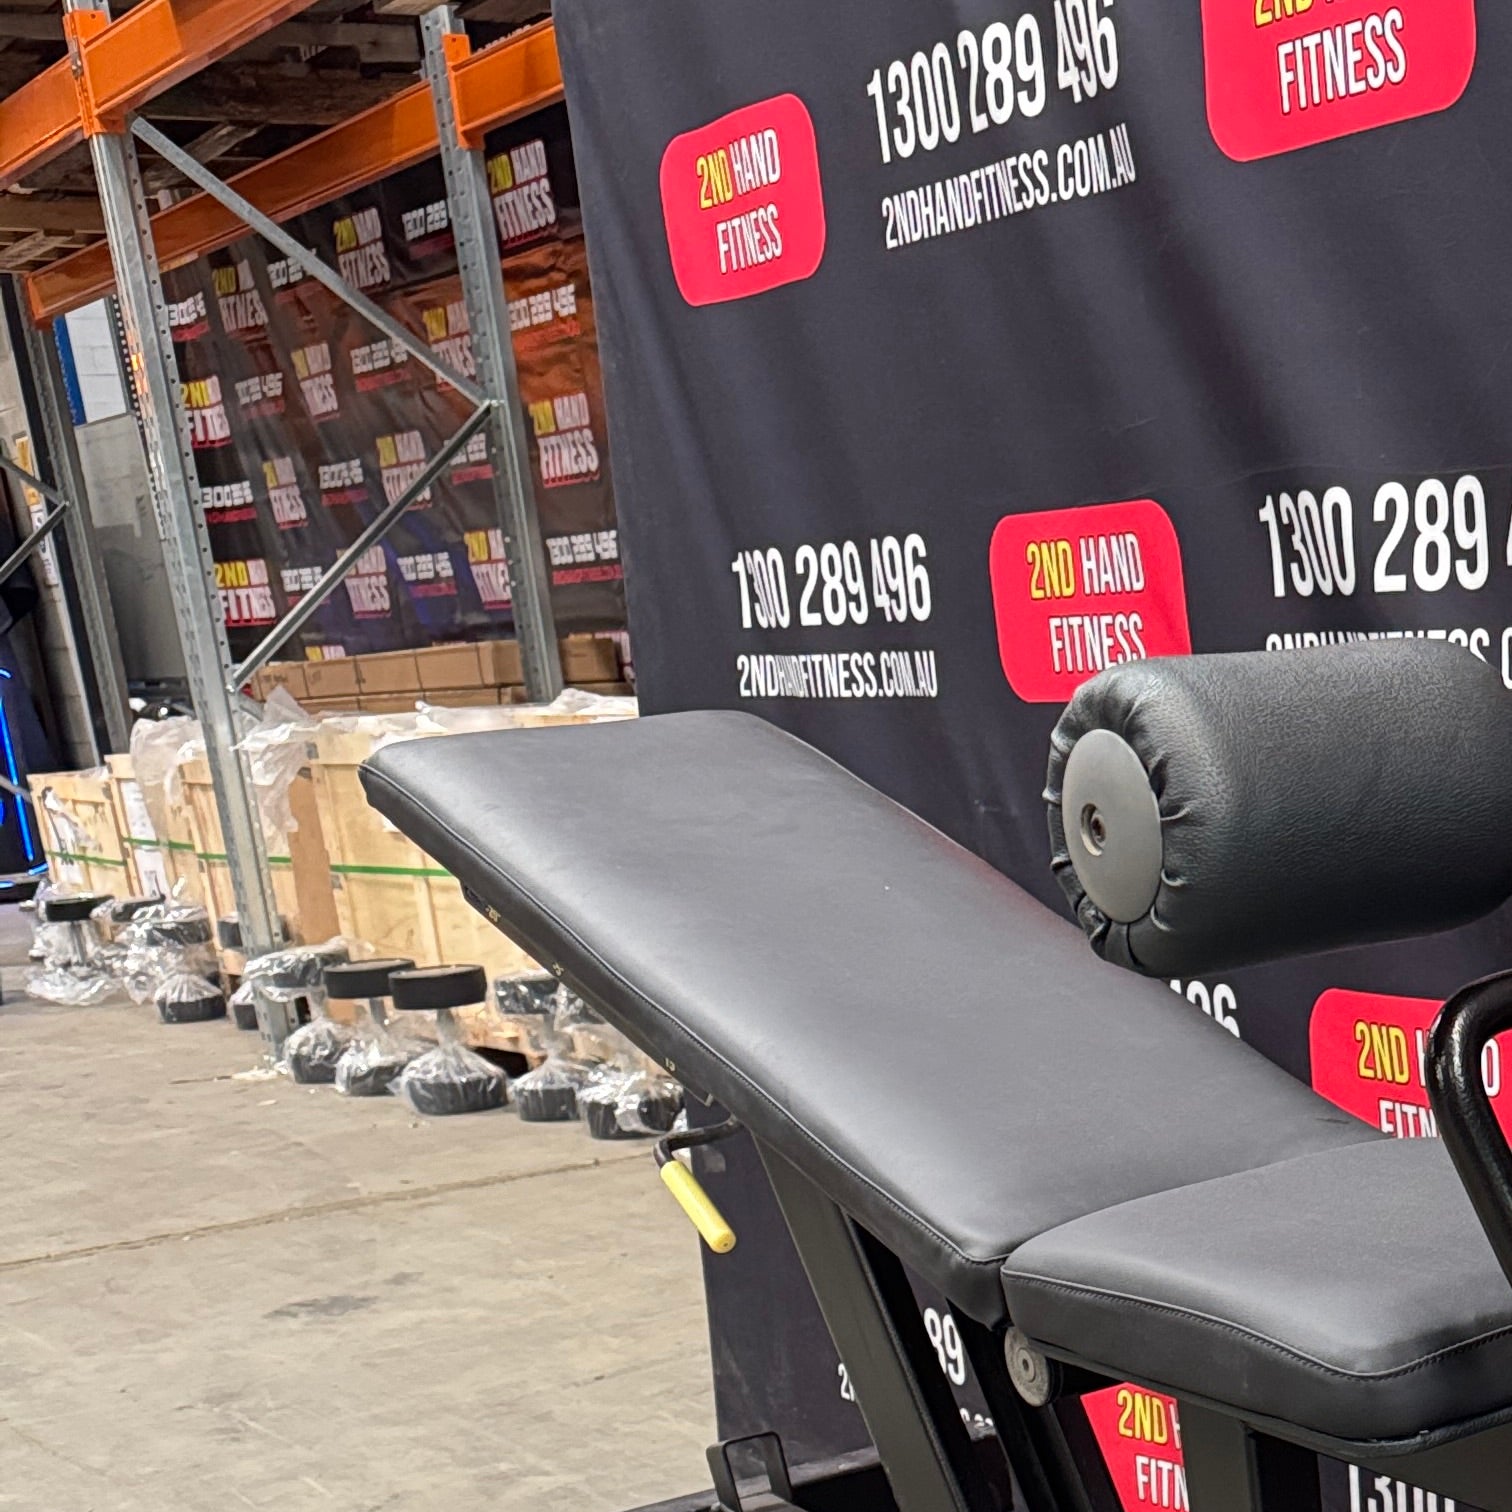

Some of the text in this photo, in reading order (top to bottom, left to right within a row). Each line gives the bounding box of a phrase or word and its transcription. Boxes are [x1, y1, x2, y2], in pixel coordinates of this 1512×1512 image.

[867, 0, 1118, 163] 1300 289 496
[1279, 10, 1405, 111] FITNESS
[697, 130, 780, 208] 2ND HAND
[882, 123, 1135, 249] 2NDHANDFITNESS.COM.AU
[494, 178, 556, 240] FITNESS
[718, 205, 781, 271] FITNESS
[538, 428, 599, 479] FITNESS
[1027, 534, 1143, 598] 2ND HAND
[1259, 486, 1355, 597] 1300
[1373, 475, 1488, 592] 289
[213, 561, 249, 587] 2ND
[732, 534, 931, 628] 1300 289 496
[1050, 612, 1146, 673] FITNESS
[1356, 1022, 1409, 1083] 2ND
[1379, 1099, 1439, 1139] FITN
[1118, 1390, 1167, 1443] 2ND
[1137, 1456, 1189, 1511] FITN
